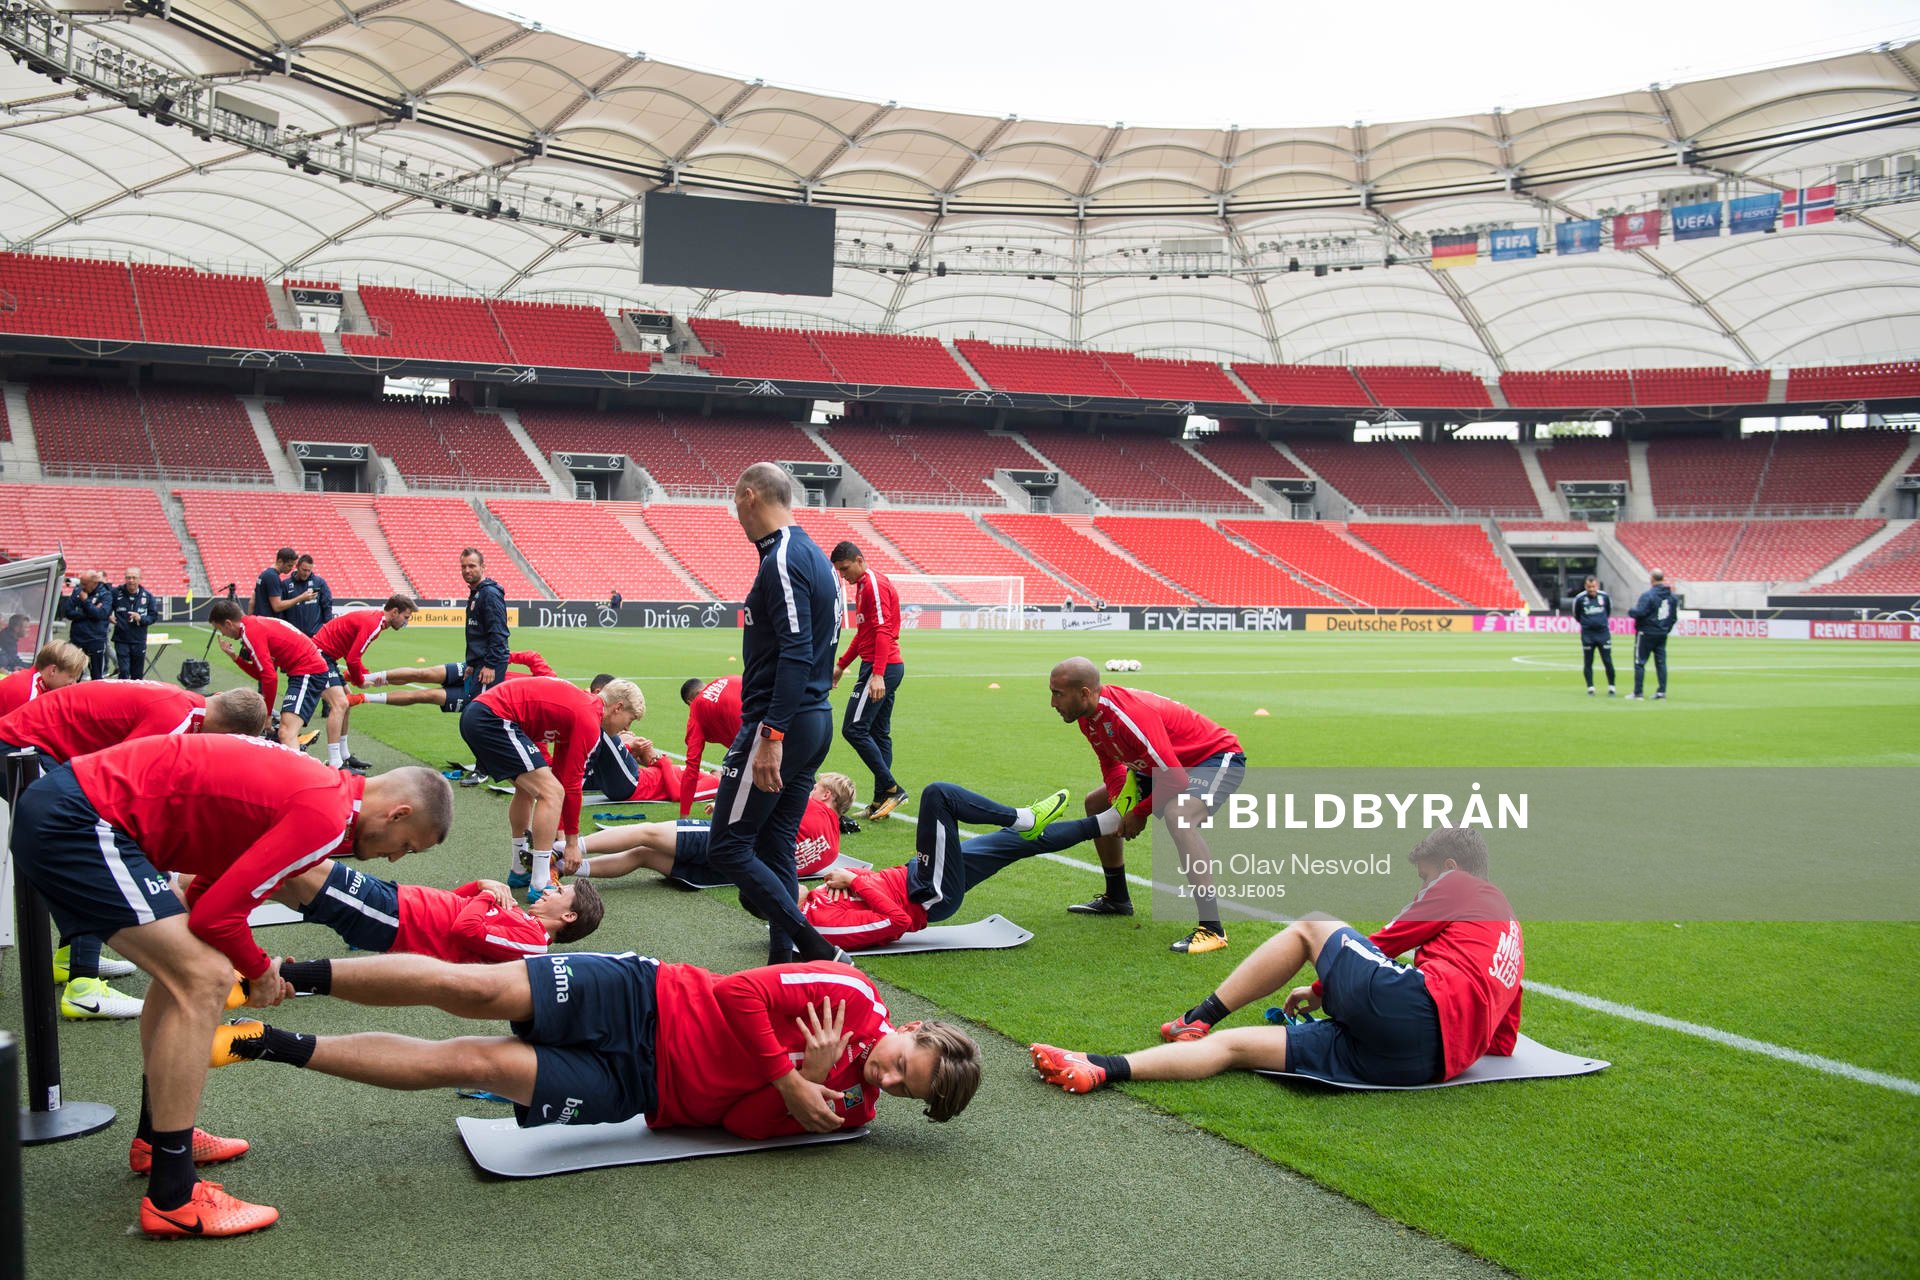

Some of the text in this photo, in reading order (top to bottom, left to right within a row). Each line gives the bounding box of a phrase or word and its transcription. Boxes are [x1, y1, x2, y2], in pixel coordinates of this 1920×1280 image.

[1676, 214, 1715, 229] UEFA
[1743, 208, 1775, 219] RESPECT
[1495, 234, 1531, 249] FIFA
[425, 613, 448, 622] Bank
[539, 608, 588, 628] Drive
[644, 609, 691, 628] Drive
[1144, 612, 1293, 630] FLYERALARM
[1326, 616, 1433, 631] Deutsche Post
[1688, 620, 1768, 637] BAUHAUS
[1814, 623, 1856, 638] REWE
[1878, 624, 1903, 639] MARKT
[551, 956, 570, 1004] bama
